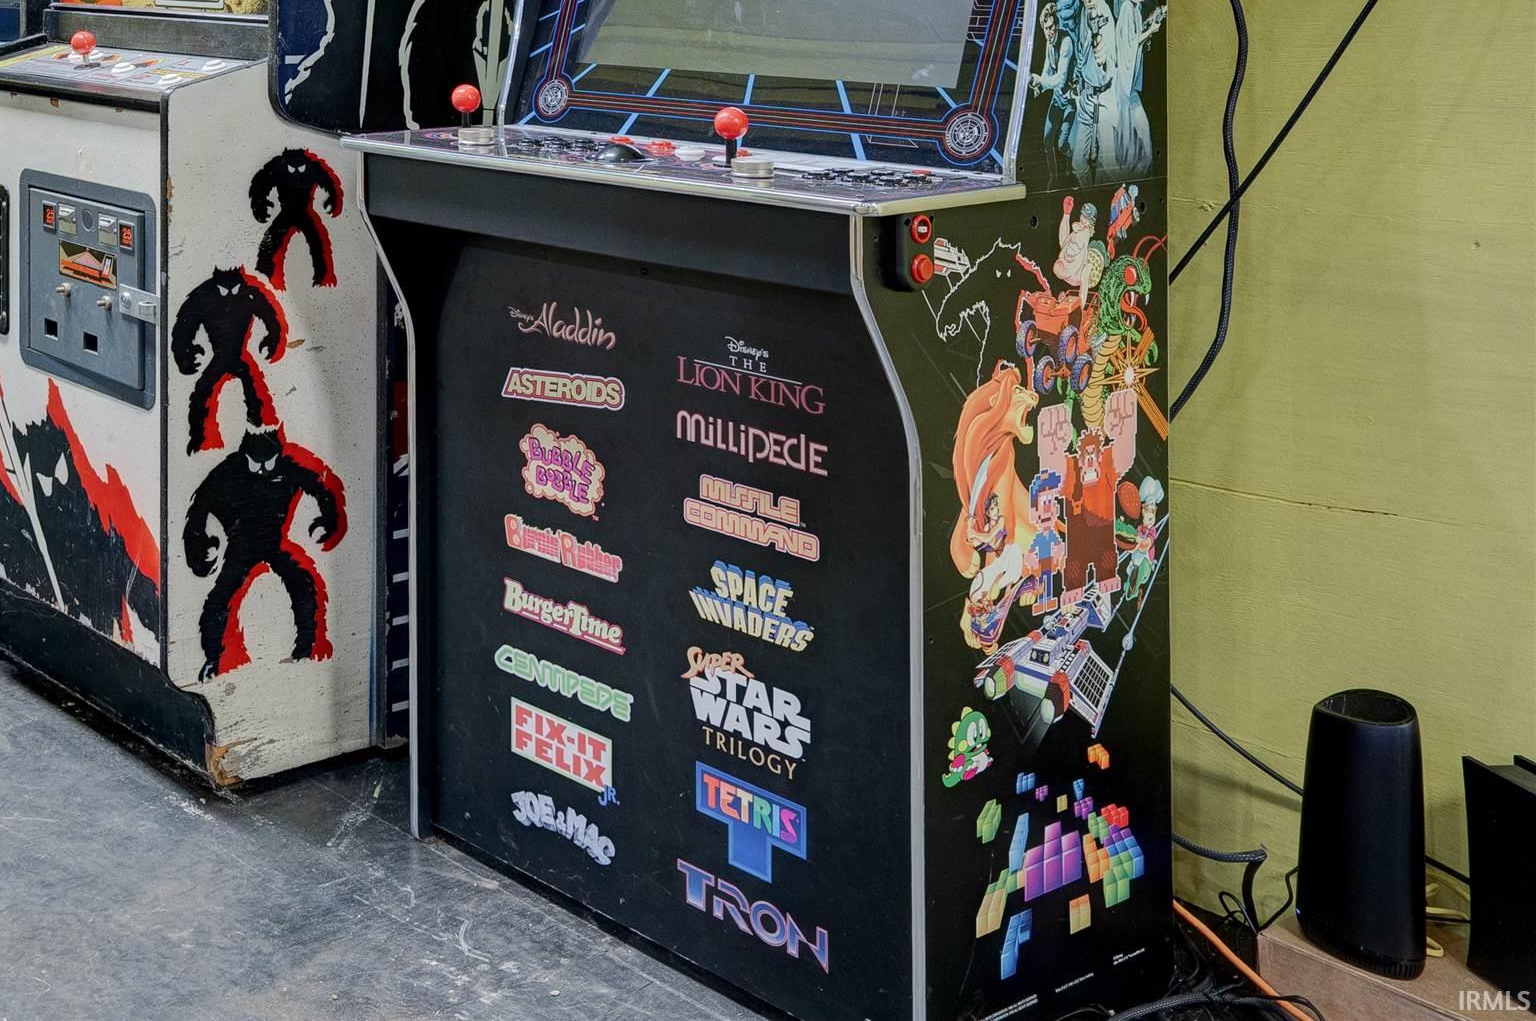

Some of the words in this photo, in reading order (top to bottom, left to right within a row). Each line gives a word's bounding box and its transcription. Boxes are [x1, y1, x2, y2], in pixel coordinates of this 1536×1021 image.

[518, 301, 617, 351] Aladdin
[505, 371, 622, 407] ASTEROIDS
[677, 356, 742, 396] LION
[748, 375, 826, 414] KING
[728, 355, 768, 373] THE
[527, 437, 596, 486] BUBBLE
[535, 464, 590, 505] BOBBLE
[684, 498, 819, 561] COMMAND
[701, 475, 800, 525] MISSILE
[504, 578, 624, 646] BurgerTime
[710, 559, 794, 618] SPACE
[689, 587, 815, 652] INVADERS
[495, 645, 633, 722] CENTIPEDE
[681, 646, 755, 678] SUPER
[690, 668, 811, 731] STAR
[690, 687, 811, 760] WARS
[515, 704, 607, 763] FIX-IT
[515, 727, 607, 788] FELIX
[702, 725, 798, 780] TRILOGY
[597, 784, 620, 806] JR.
[703, 773, 798, 844] TETRIS
[676, 857, 829, 975] TRON
